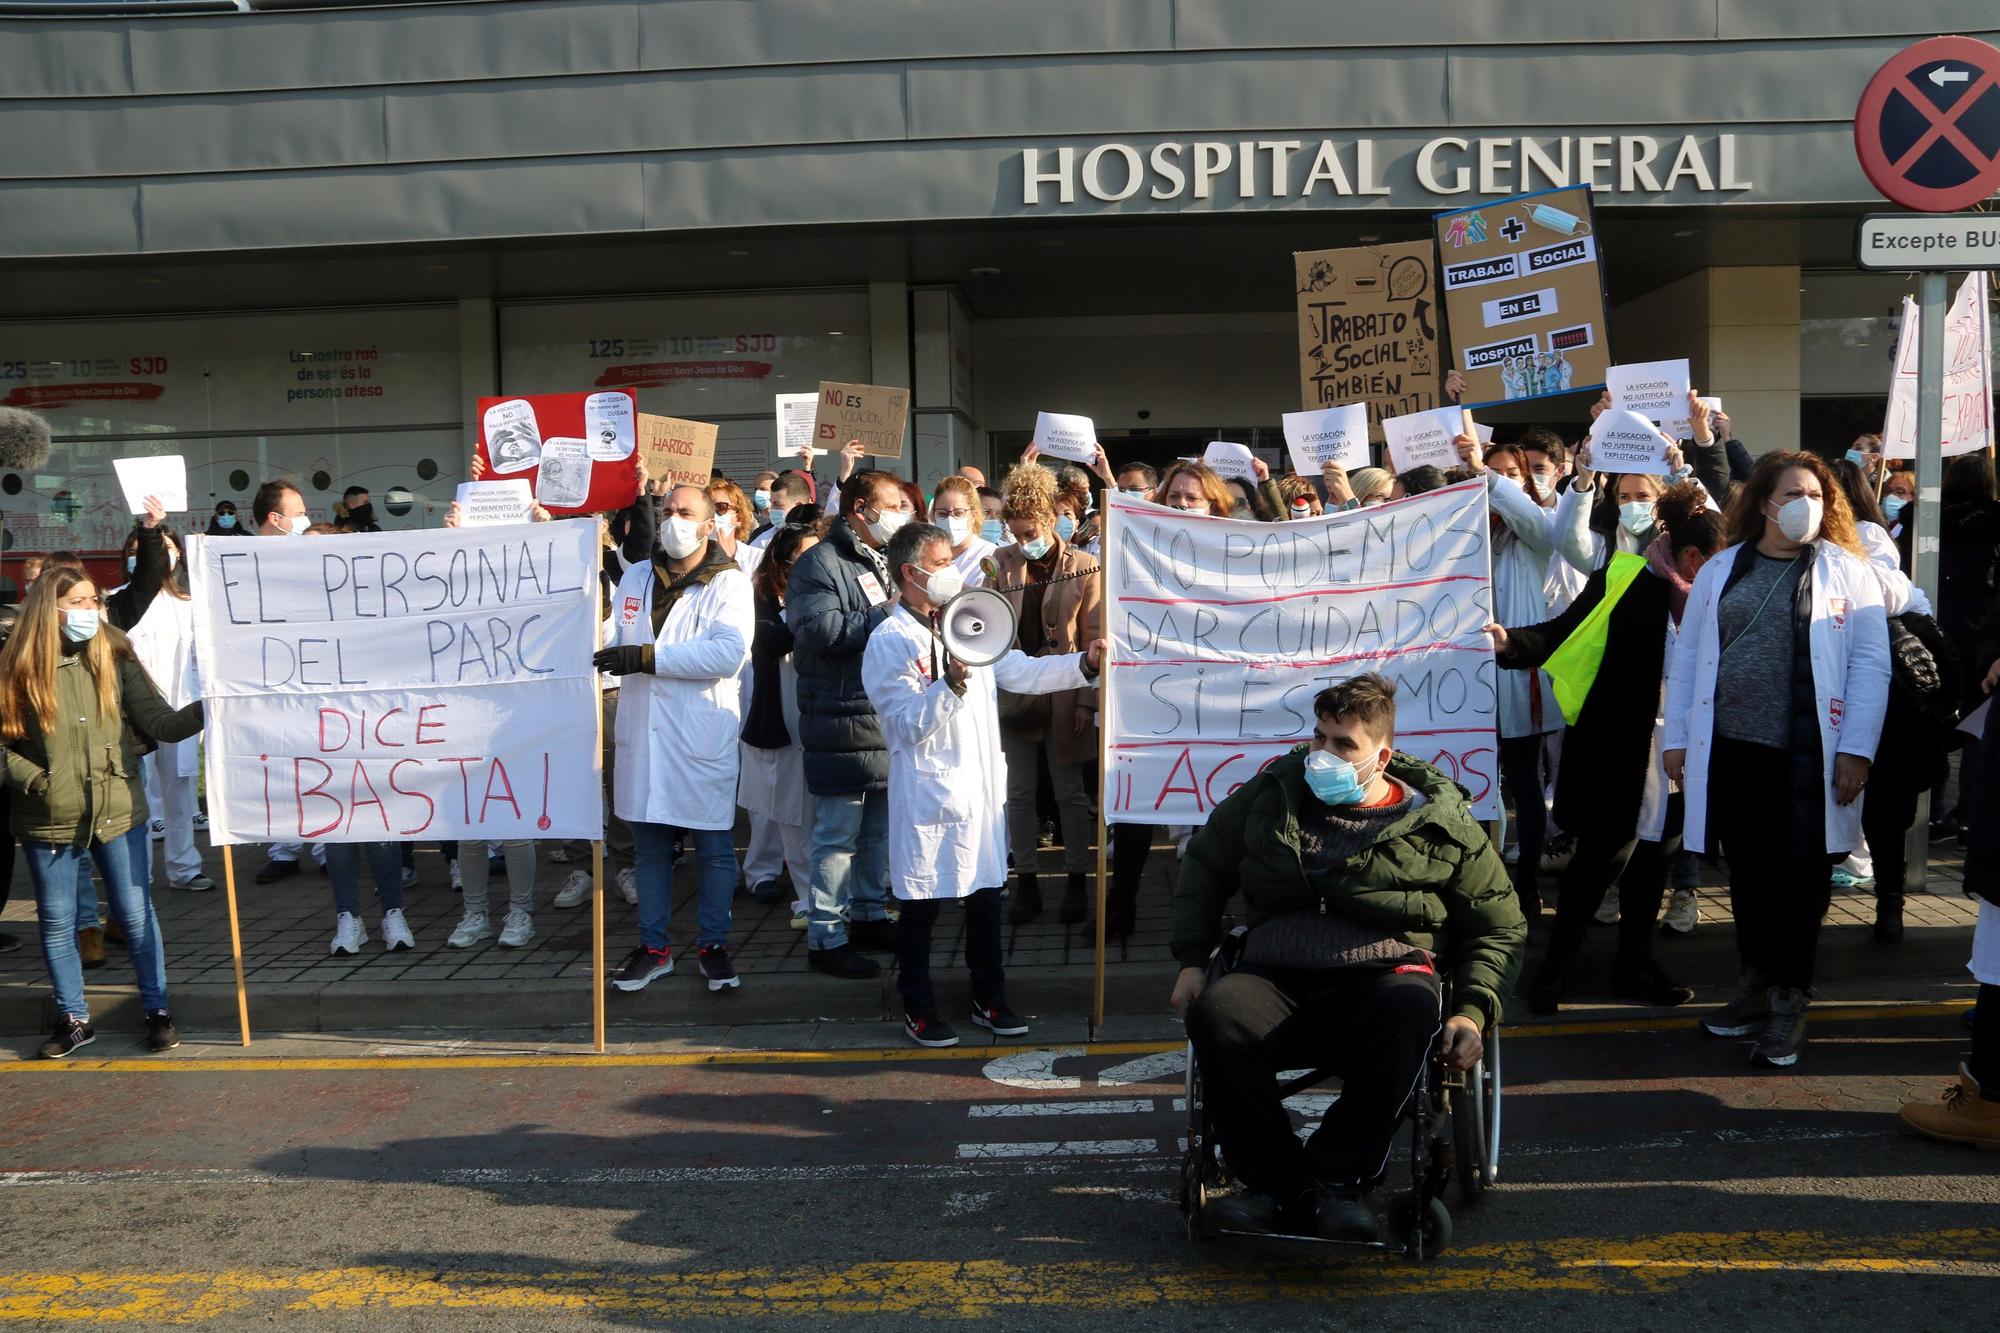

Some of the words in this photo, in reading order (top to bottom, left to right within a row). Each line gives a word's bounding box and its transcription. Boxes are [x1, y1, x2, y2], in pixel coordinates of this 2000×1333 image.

[1022, 138, 1391, 204] HOSPITAL
[1416, 133, 1753, 195] GENERAL
[1872, 231, 1957, 254] Excepte
[1966, 230, 2000, 248] BU
[1448, 261, 1514, 283] TRABAJO
[1533, 245, 1586, 267] SOCIAL
[1500, 303, 1519, 316] EN
[1523, 299, 1541, 312] EL
[1308, 302, 1407, 345] TRABAJO
[356, 345, 378, 361] raó
[589, 338, 625, 359] 125
[671, 336, 694, 355] 10
[736, 333, 776, 354] SJD
[1470, 339, 1535, 365] HOSPITAL
[1334, 341, 1408, 373] SOCIAL
[129, 356, 168, 376] SJD
[297, 367, 314, 381] de
[317, 368, 338, 380] ser
[341, 365, 356, 379] és
[359, 364, 371, 379] la
[622, 366, 640, 377] Parc
[674, 365, 692, 376] Sant
[693, 364, 717, 375] Joan
[1635, 380, 1669, 389] VOCACIÓN
[287, 386, 342, 403] persona
[345, 384, 384, 398] atesa
[825, 389, 843, 406] NO
[846, 394, 862, 408] ES
[1634, 392, 1664, 400] JUSTIFICA
[1627, 400, 1671, 409] EXPLOTACIÓN
[502, 411, 514, 419] NO
[819, 423, 837, 439] ES
[1311, 430, 1346, 441] VOCACIÓN
[1413, 429, 1442, 440] VOCACIÓN
[652, 437, 695, 456] HARTOS
[1048, 444, 1082, 452] EXPLOTACIÓN
[1056, 437, 1079, 445] JUSTIFICA
[1311, 442, 1342, 451] JUSTIFICA
[1613, 442, 1645, 451] JUSTIFICA
[1308, 451, 1349, 462] EXPLOTACIÓN
[470, 504, 512, 512] INCREMENTO
[469, 513, 501, 521] PERSONAL
[1120, 525, 1198, 591] NO
[1223, 503, 1484, 592] PODEMOS
[220, 551, 287, 625] EL
[322, 540, 583, 621] PERSONAL
[1126, 607, 1225, 657] DAR
[1238, 586, 1494, 658] CUIDADOS
[262, 636, 368, 688] DEL
[427, 614, 554, 683] PARC
[1238, 659, 1497, 738] ESTMOS
[318, 704, 447, 752] DICE
